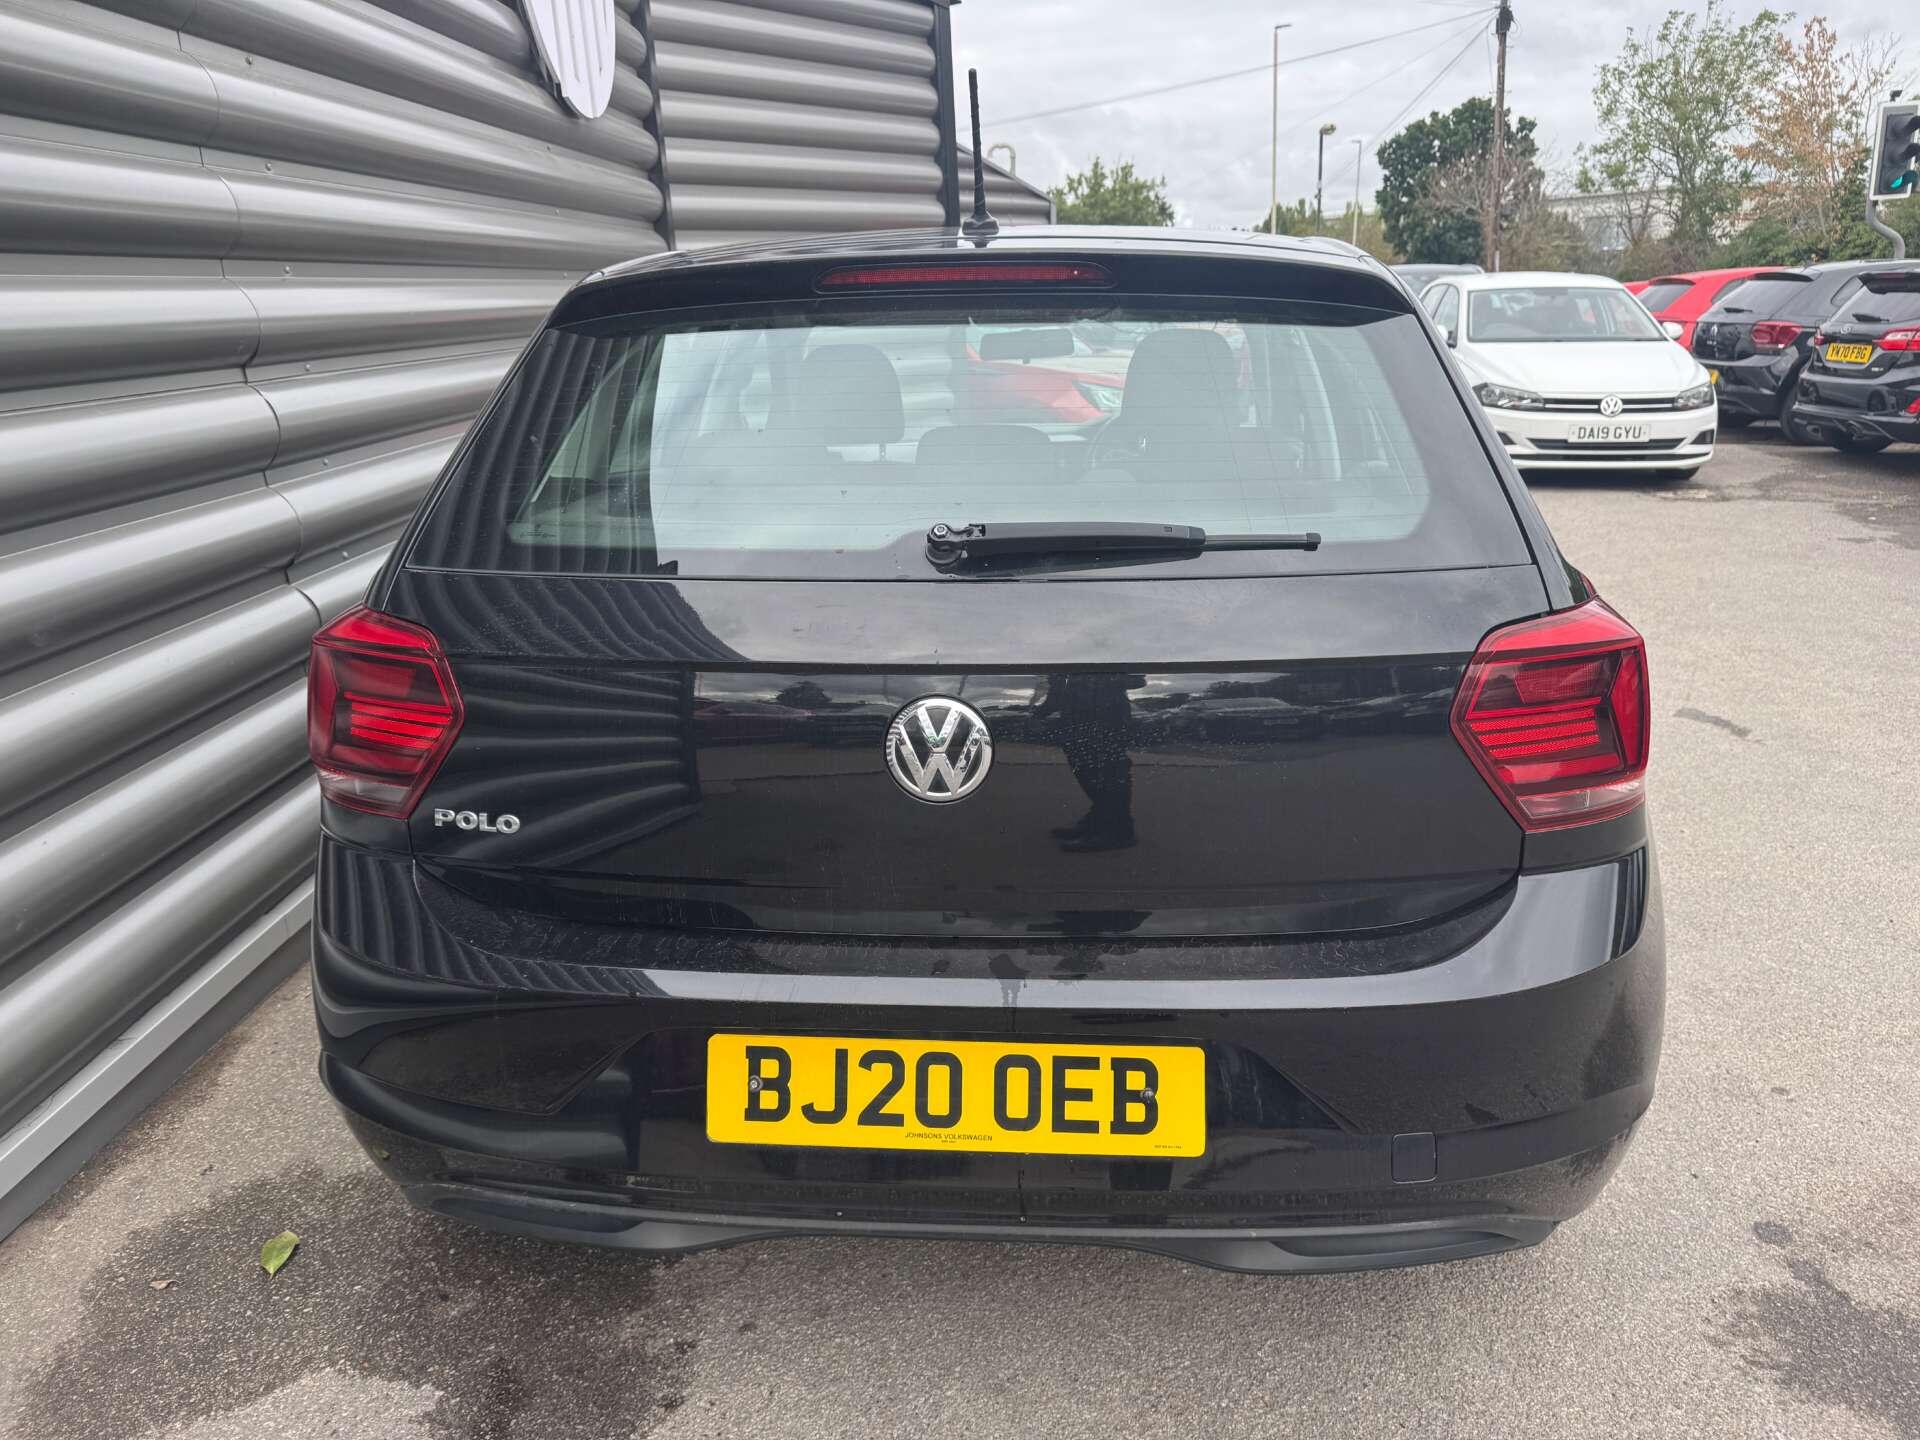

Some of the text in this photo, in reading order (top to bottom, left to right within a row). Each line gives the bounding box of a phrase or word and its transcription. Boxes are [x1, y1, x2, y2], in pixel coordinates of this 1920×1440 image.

[1578, 426, 1642, 440] DA19 GYU
[434, 807, 520, 834] POLO
[744, 1045, 1159, 1135] BJ20 OEB
[905, 1132, 993, 1141] JOHNSONS VOLKSWAGEN
